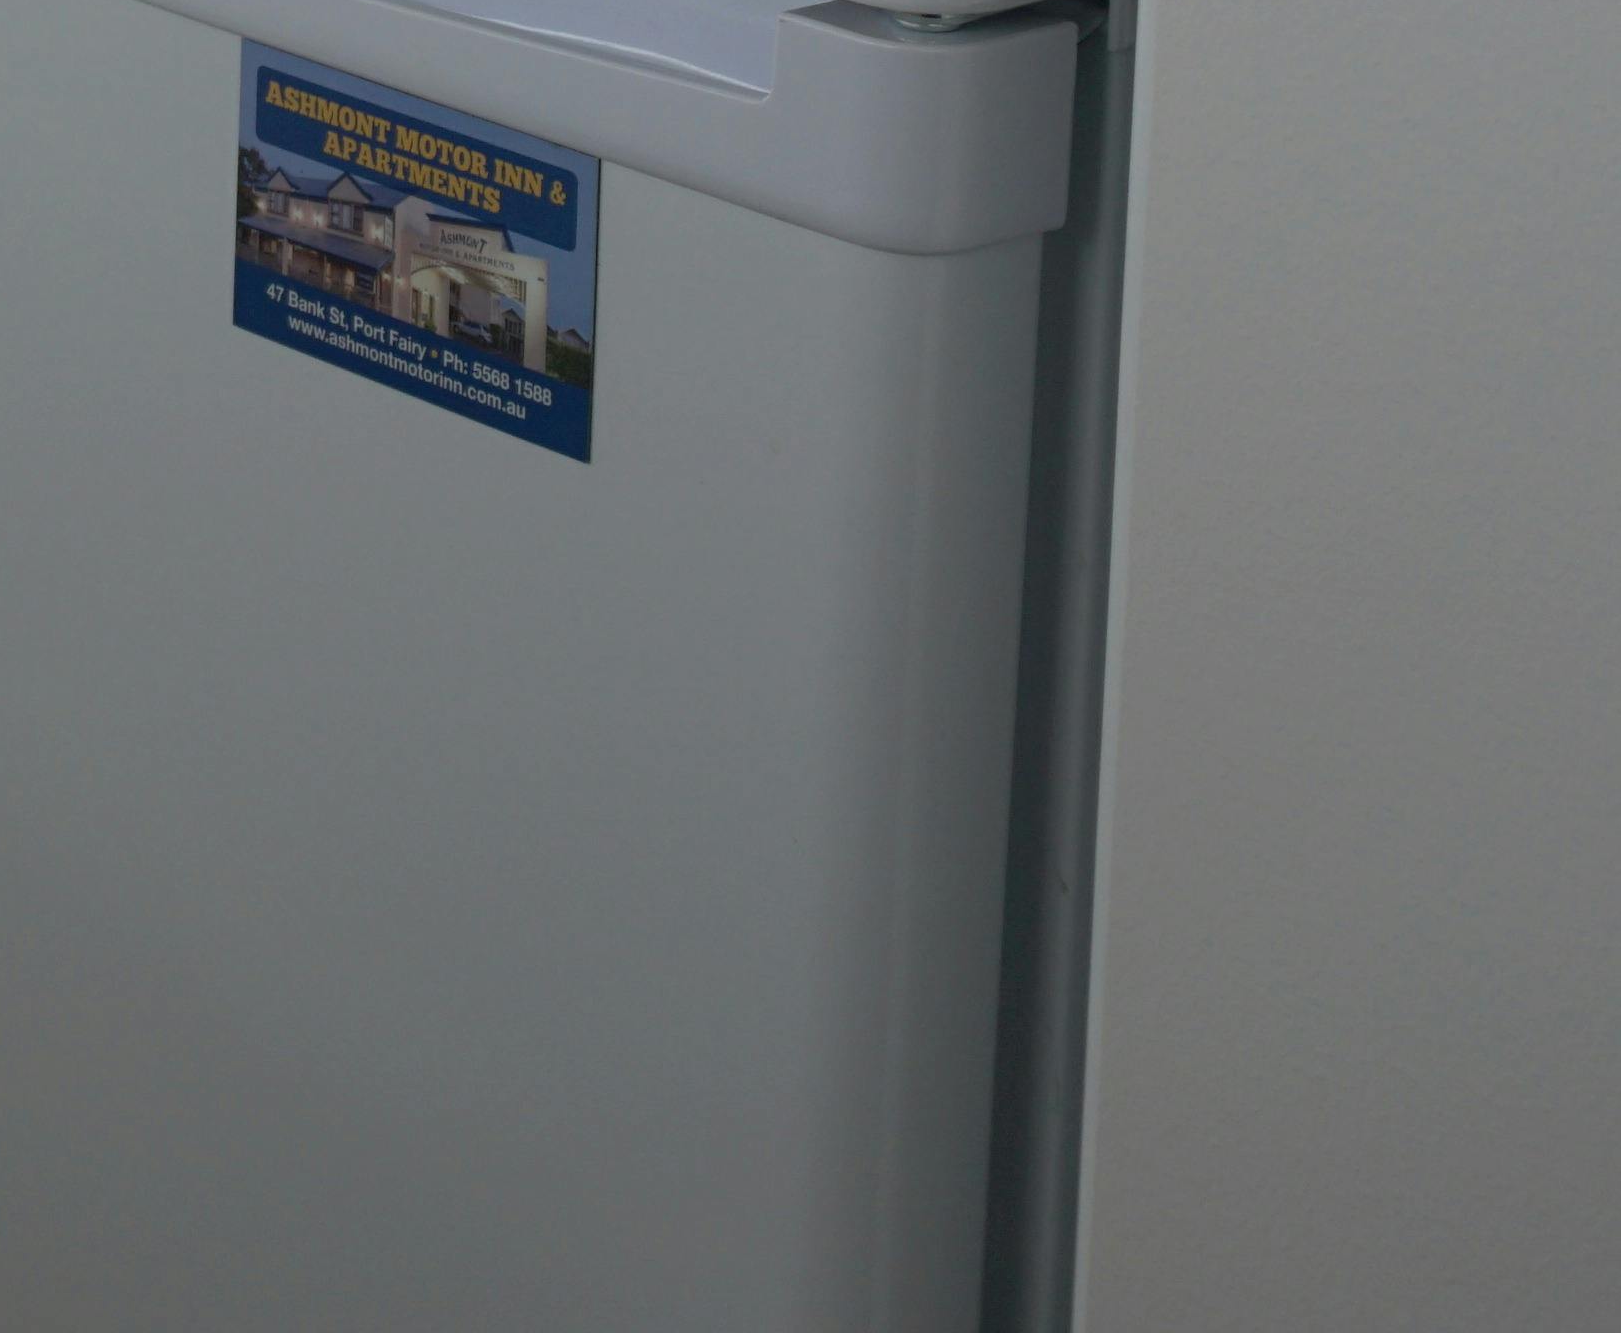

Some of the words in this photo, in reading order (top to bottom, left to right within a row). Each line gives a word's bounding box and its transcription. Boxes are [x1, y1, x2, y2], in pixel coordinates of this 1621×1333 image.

[265, 80, 391, 143] ASHMONT
[396, 124, 488, 178] MOTOR
[494, 159, 543, 197] INN
[549, 181, 566, 206] &
[323, 131, 501, 213] APARTMENTS
[266, 283, 284, 302] 47
[288, 291, 325, 319] Bank
[329, 307, 348, 331] St,
[353, 315, 385, 344] Port
[389, 329, 427, 360] Fairy
[443, 350, 468, 374] Ph:
[472, 362, 509, 390] 5568
[515, 379, 552, 406] 1588
[288, 315, 526, 419] www.ashmontmotorinn.com.au
